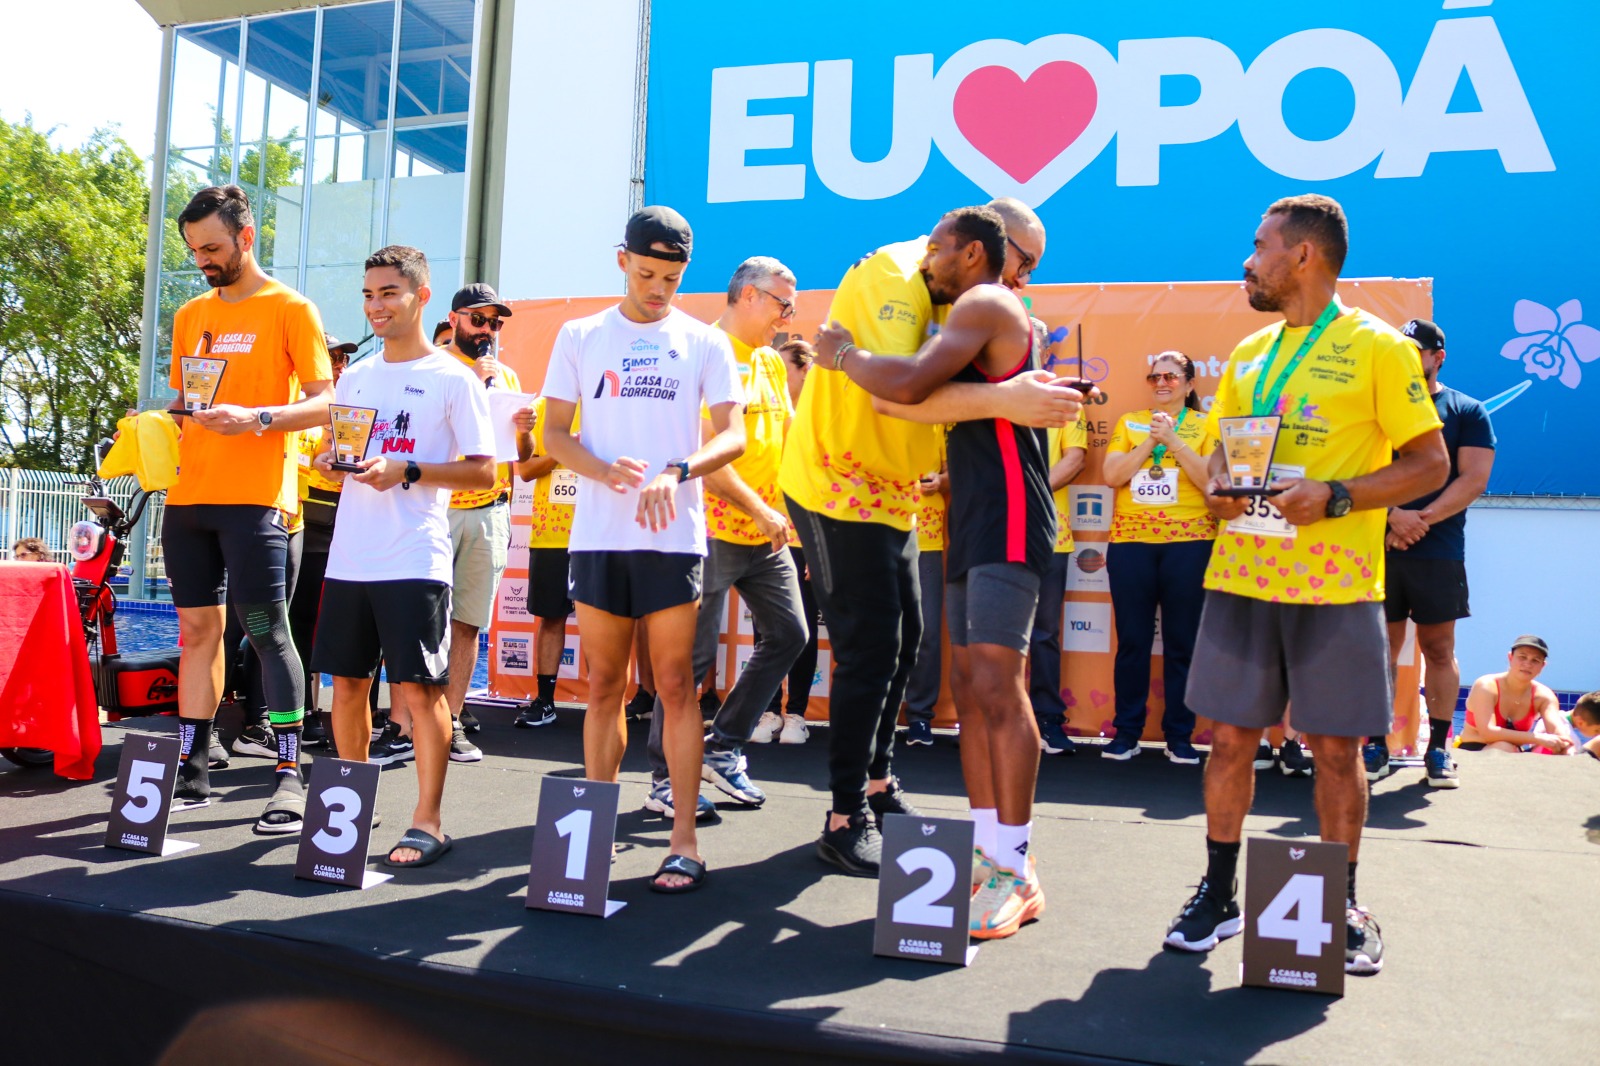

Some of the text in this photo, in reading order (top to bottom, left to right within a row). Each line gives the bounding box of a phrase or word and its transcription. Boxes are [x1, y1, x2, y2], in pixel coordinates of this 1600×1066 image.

[707, 53, 934, 203] EU
[215, 334, 256, 344] A CASA DO
[211, 343, 253, 354] CORREDOR
[631, 343, 660, 351] vante
[623, 375, 680, 390] A CASA DO
[620, 386, 677, 401] CORREDOR
[1138, 484, 1171, 496] 6510
[1070, 620, 1092, 631] YOU
[120, 759, 166, 824] 5
[311, 786, 362, 855] 3
[127, 833, 140, 841] CASA
[121, 838, 148, 848] CORREDOR
[555, 809, 593, 880] 1
[313, 869, 345, 880] CORREDOR
[320, 865, 336, 873] CASA
[892, 846, 956, 928] 2
[554, 891, 573, 900] CASA
[547, 896, 584, 907] CORREDOR
[1257, 873, 1333, 957] 4
[899, 938, 942, 949] A CASA DO
[898, 944, 942, 956] CORREDOR
[1269, 968, 1317, 979] A CASA DO
[1269, 974, 1317, 987] CORREDOR
